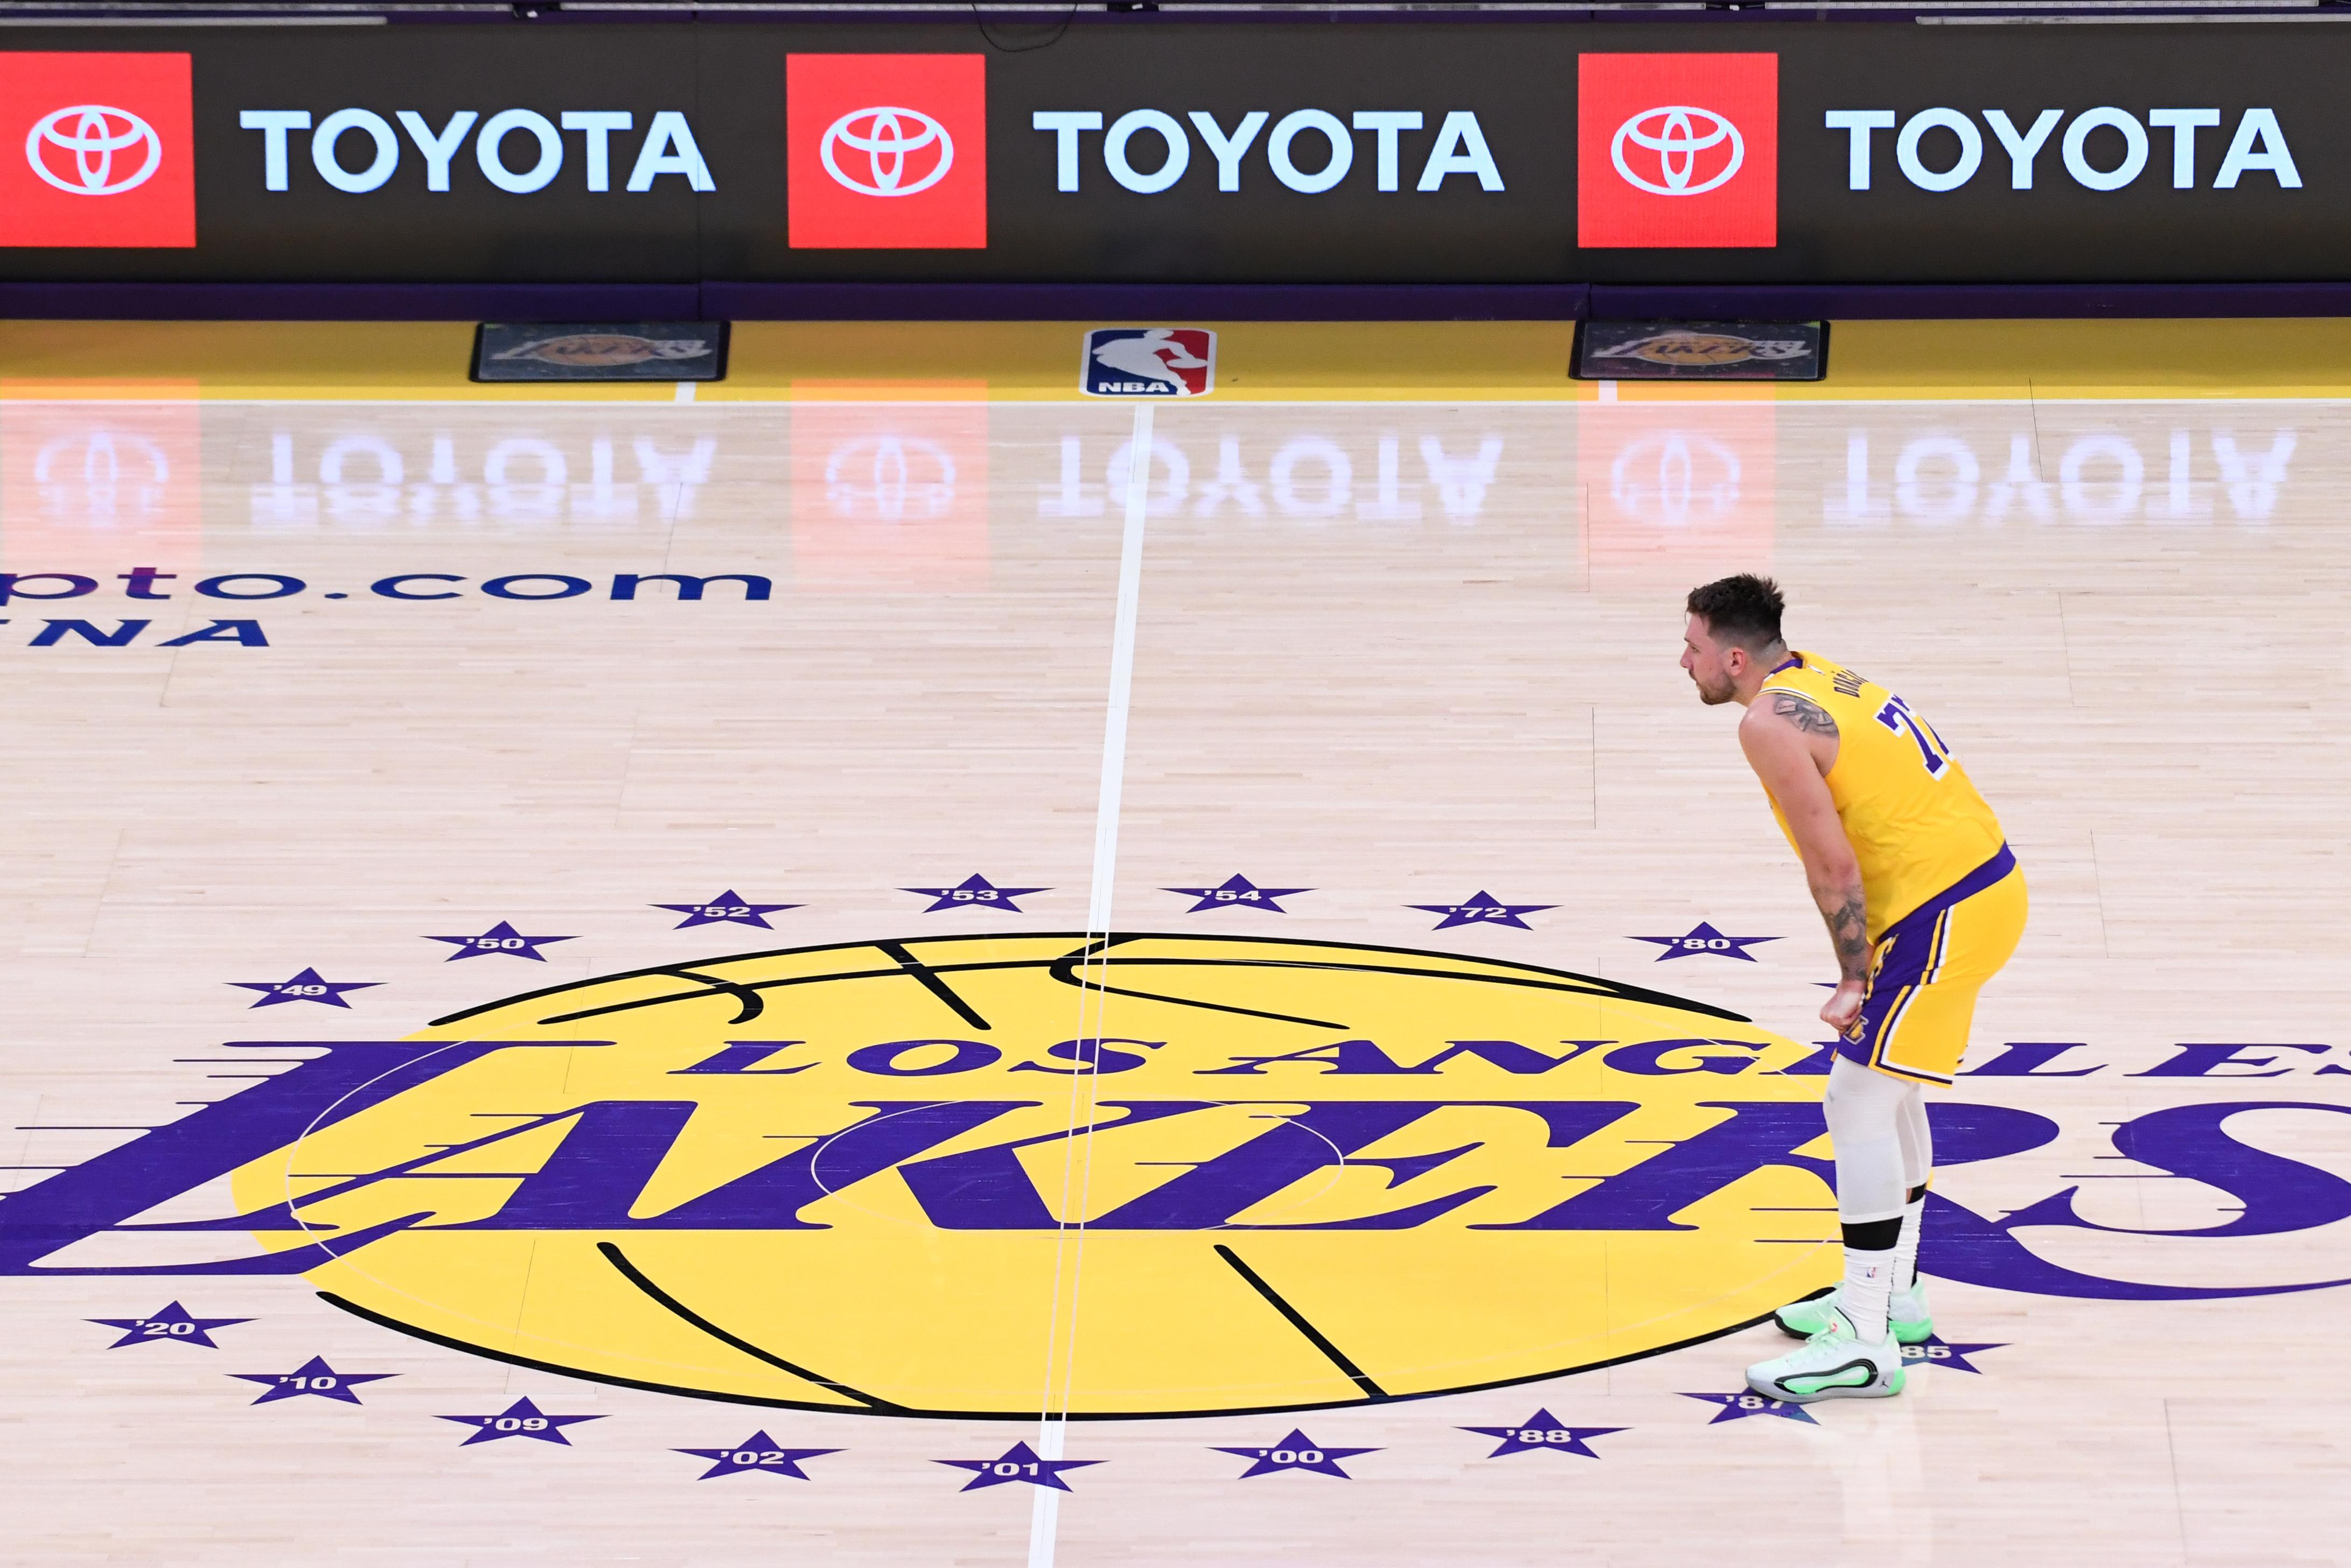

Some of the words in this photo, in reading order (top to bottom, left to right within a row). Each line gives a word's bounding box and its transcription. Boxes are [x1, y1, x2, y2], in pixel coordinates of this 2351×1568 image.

[240, 108, 716, 194] TOYOTA
[1033, 109, 1505, 194] TOYOTA
[1826, 107, 2303, 192] TOYOTA
[1098, 381, 1169, 393] NBA
[0, 619, 269, 647] NA
[941, 889, 999, 901] '53
[1204, 889, 1262, 901] '54
[693, 906, 751, 917] '52
[1449, 907, 1508, 918] '72
[466, 938, 525, 950] '50
[1672, 938, 1731, 950] '80
[274, 984, 327, 996] '49
[666, 1039, 1168, 1077] LOS
[1192, 1037, 2351, 1077] ANGLE
[0, 1041, 2351, 1300] LAKERS
[135, 1320, 196, 1335] '20
[279, 1376, 337, 1390] '10
[484, 1418, 549, 1431] '09
[1506, 1430, 1572, 1444] '88
[720, 1451, 785, 1465] '02
[1259, 1449, 1324, 1464] '00
[982, 1462, 1039, 1476] '01
